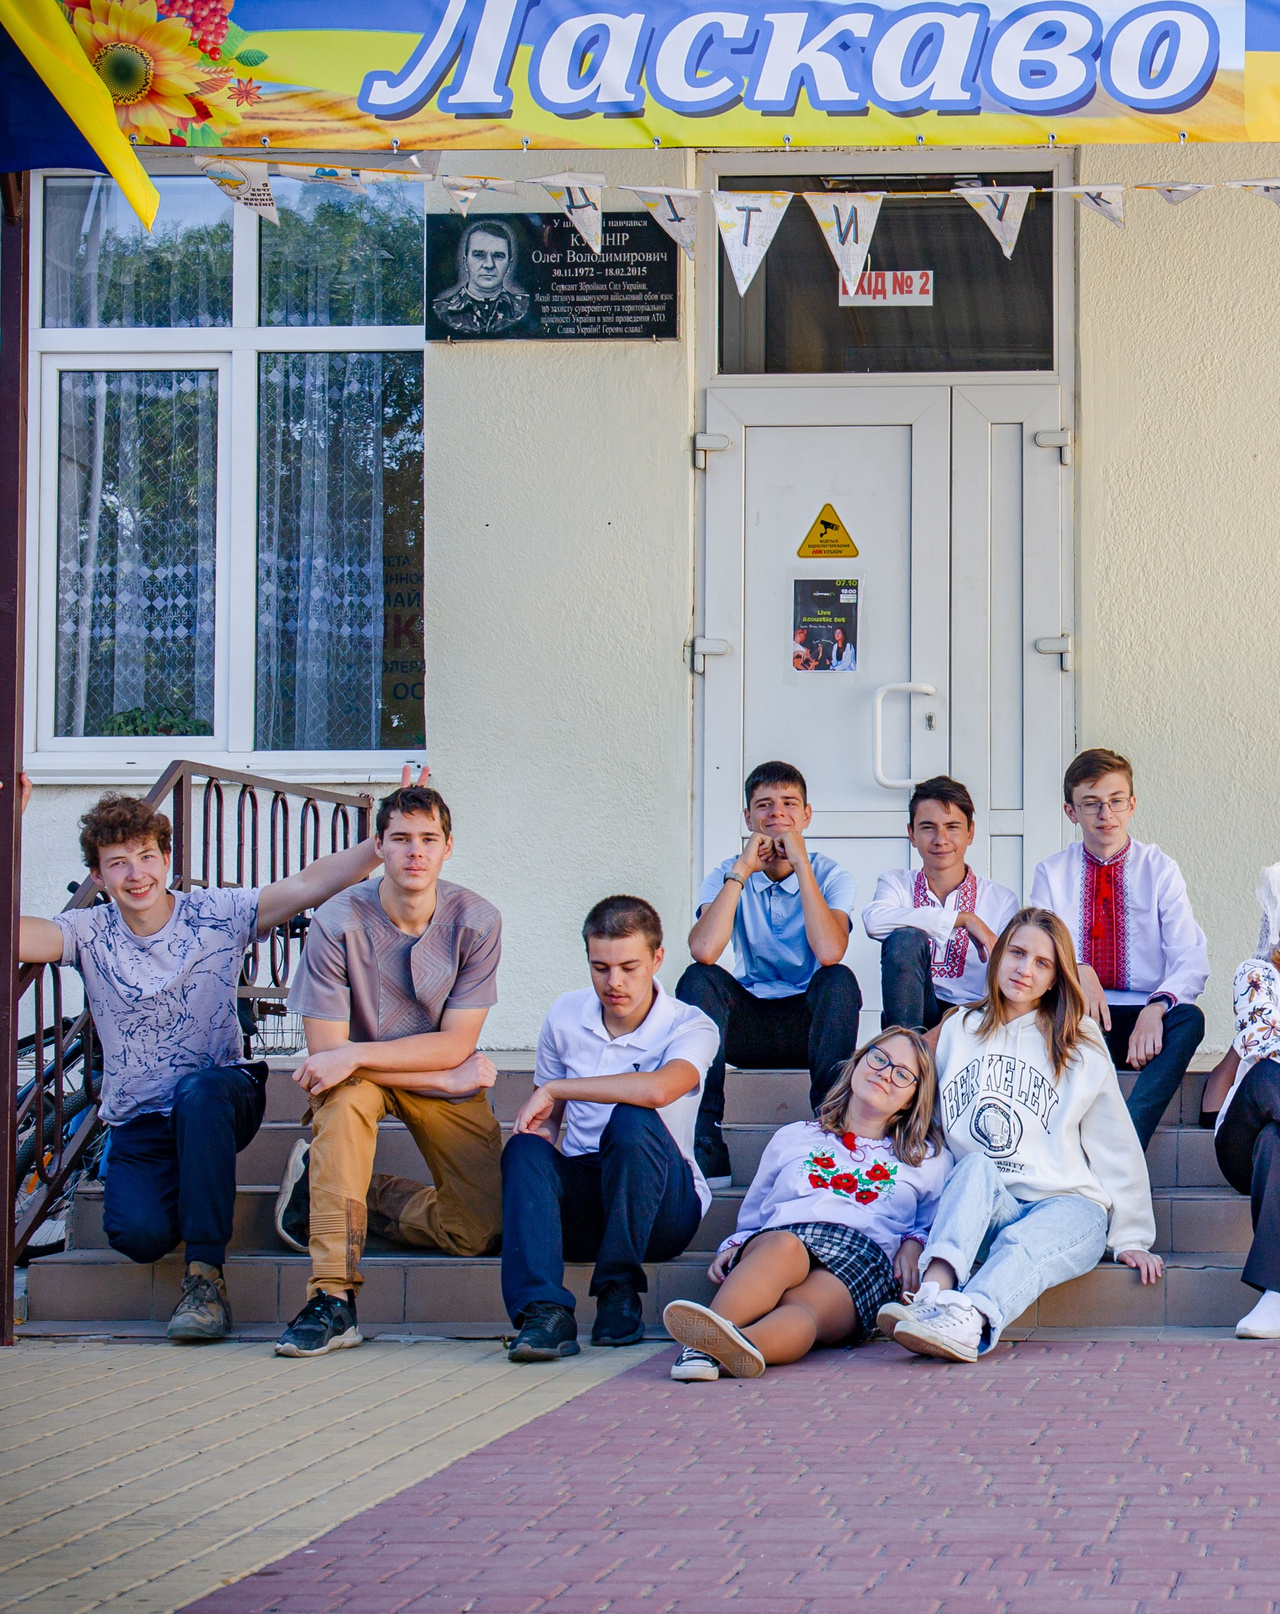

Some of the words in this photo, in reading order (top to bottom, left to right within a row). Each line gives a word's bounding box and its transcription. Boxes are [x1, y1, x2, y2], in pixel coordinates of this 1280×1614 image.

[360, 0, 1220, 115] Ласкаво
[571, 233, 630, 246] КНІР
[532, 251, 563, 263] Олег
[567, 250, 668, 265] Володимирович
[552, 268, 594, 277] 30.11.1972
[605, 266, 648, 277] 18.02.2015
[919, 272, 930, 295] 2
[943, 1054, 1059, 1133] BERKELEY
